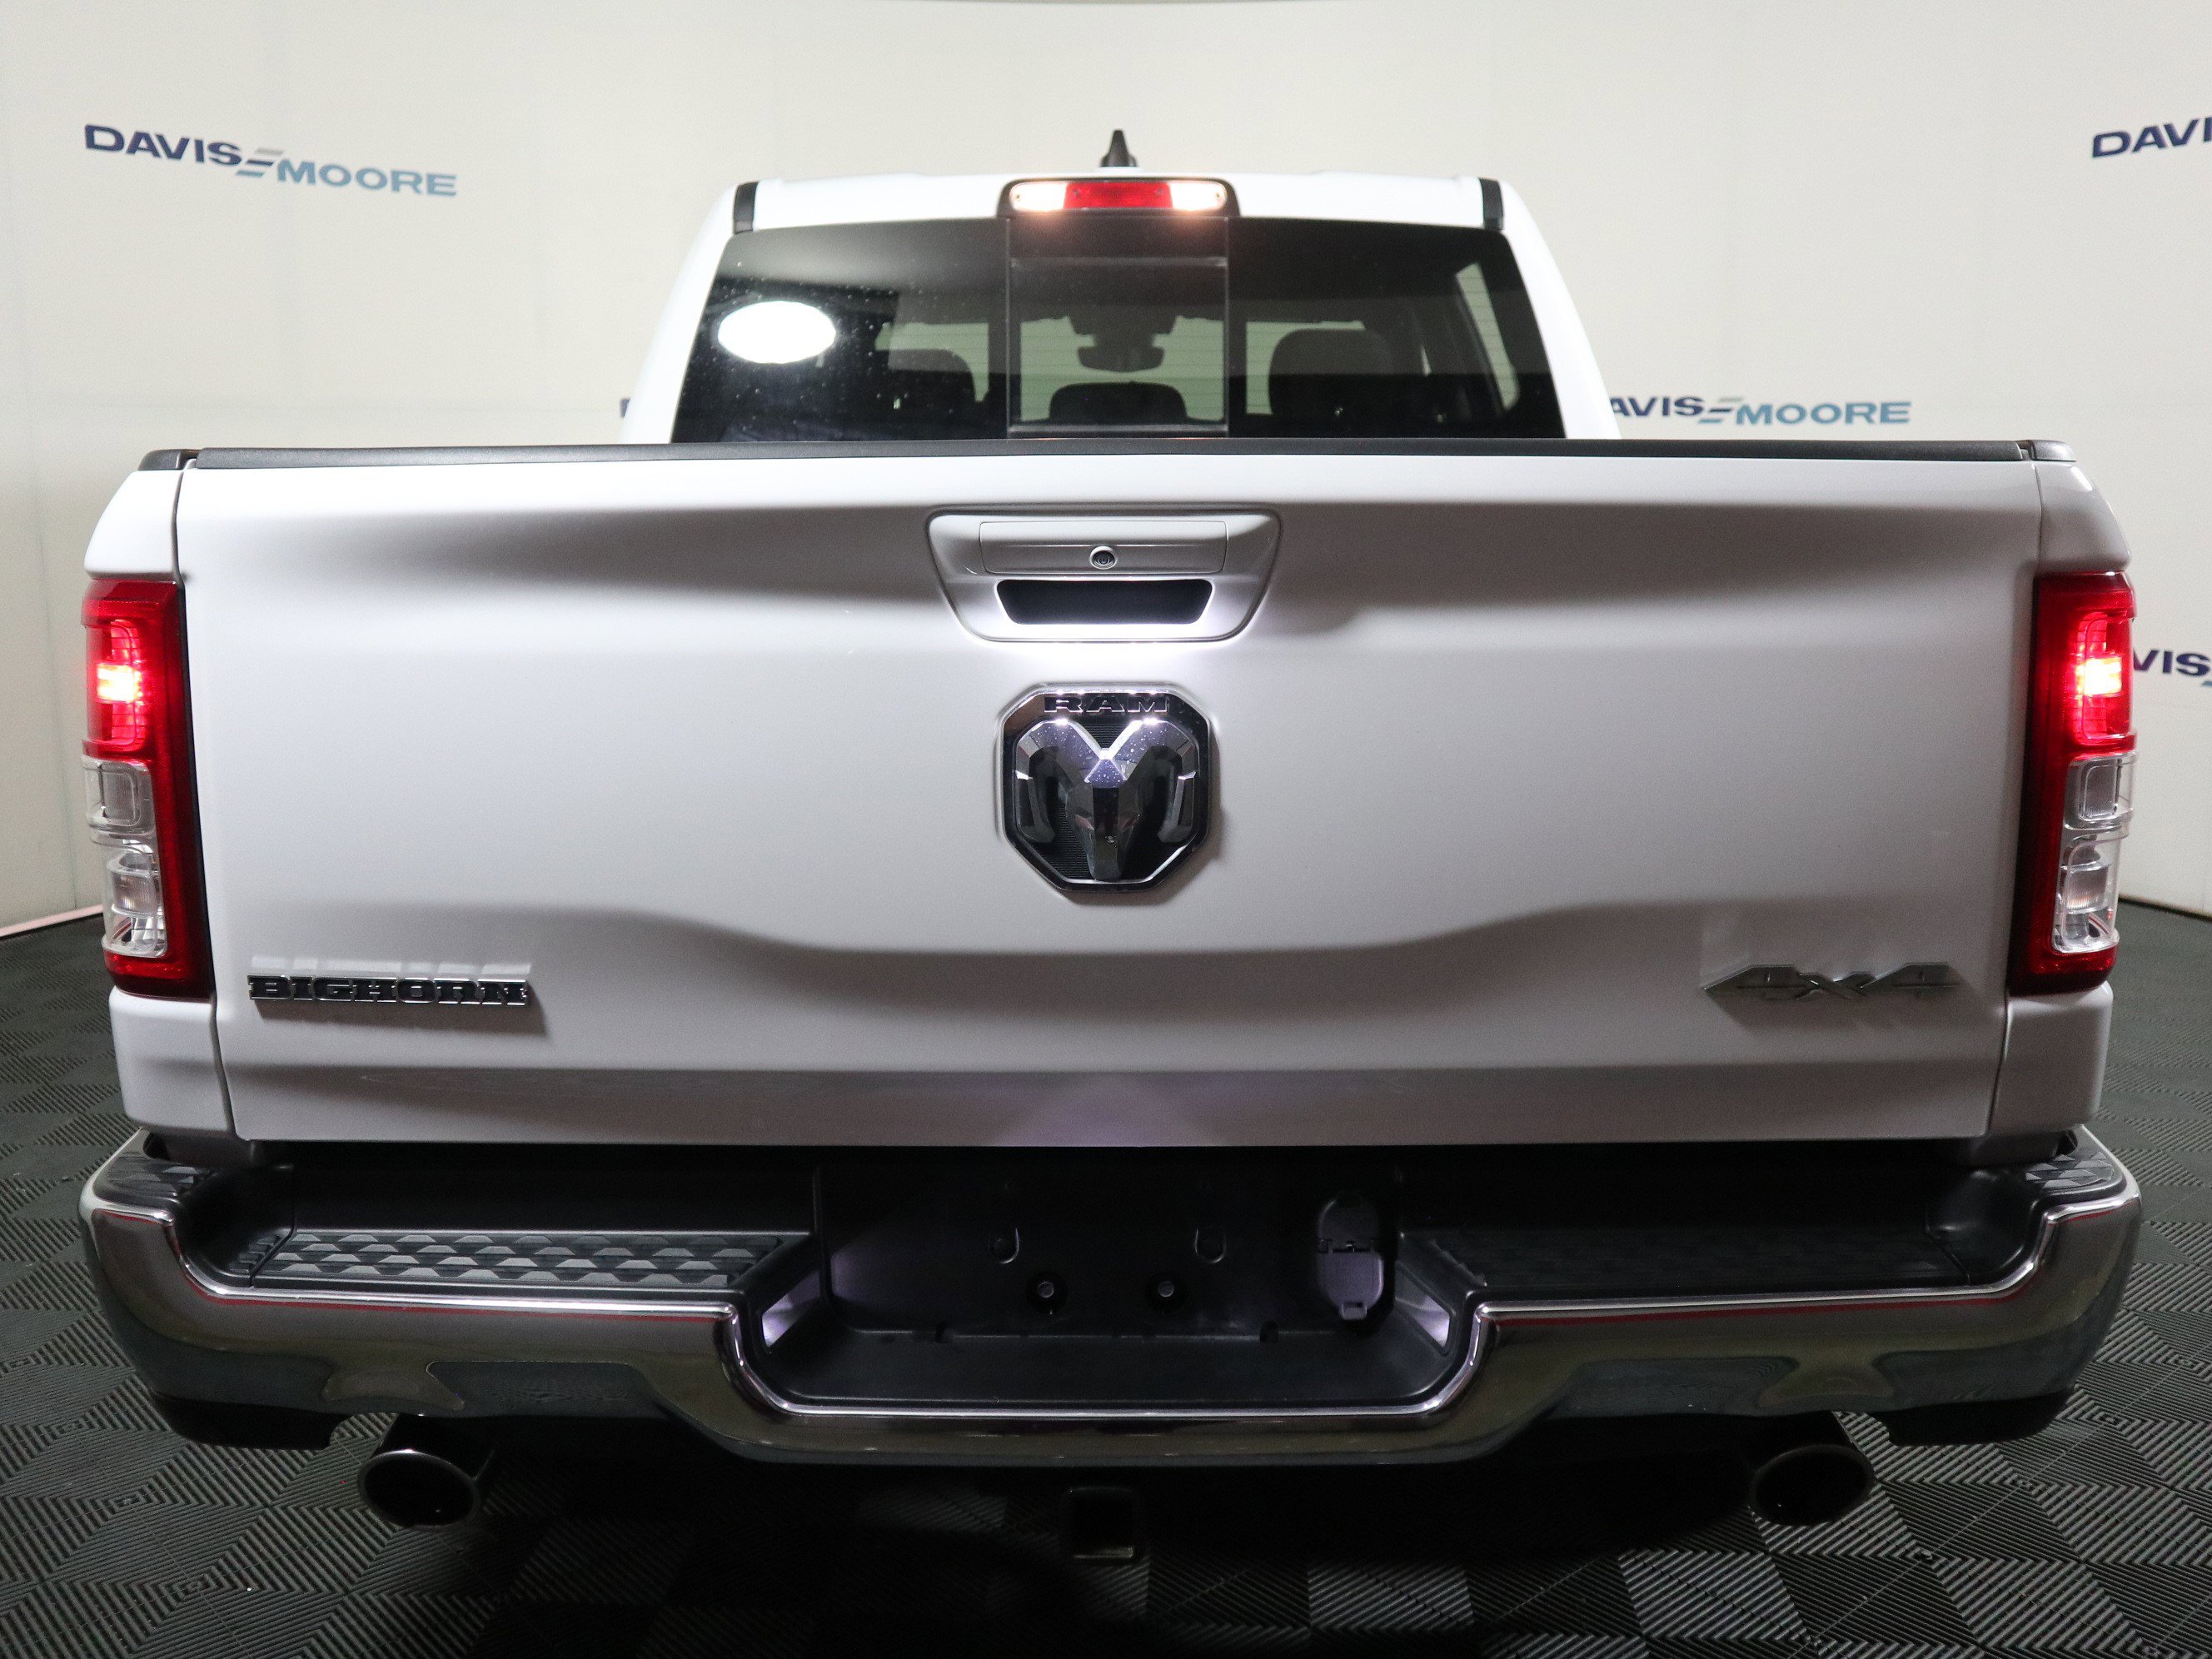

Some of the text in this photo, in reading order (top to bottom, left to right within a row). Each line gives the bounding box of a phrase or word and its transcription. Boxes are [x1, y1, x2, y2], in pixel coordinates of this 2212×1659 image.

[2091, 116, 2212, 157] DAVI
[84, 124, 457, 197] DAVIS MOORE
[1610, 396, 1912, 426] AVIS MOORE
[2133, 650, 2210, 676] VIS
[1044, 696, 1168, 713] RAM
